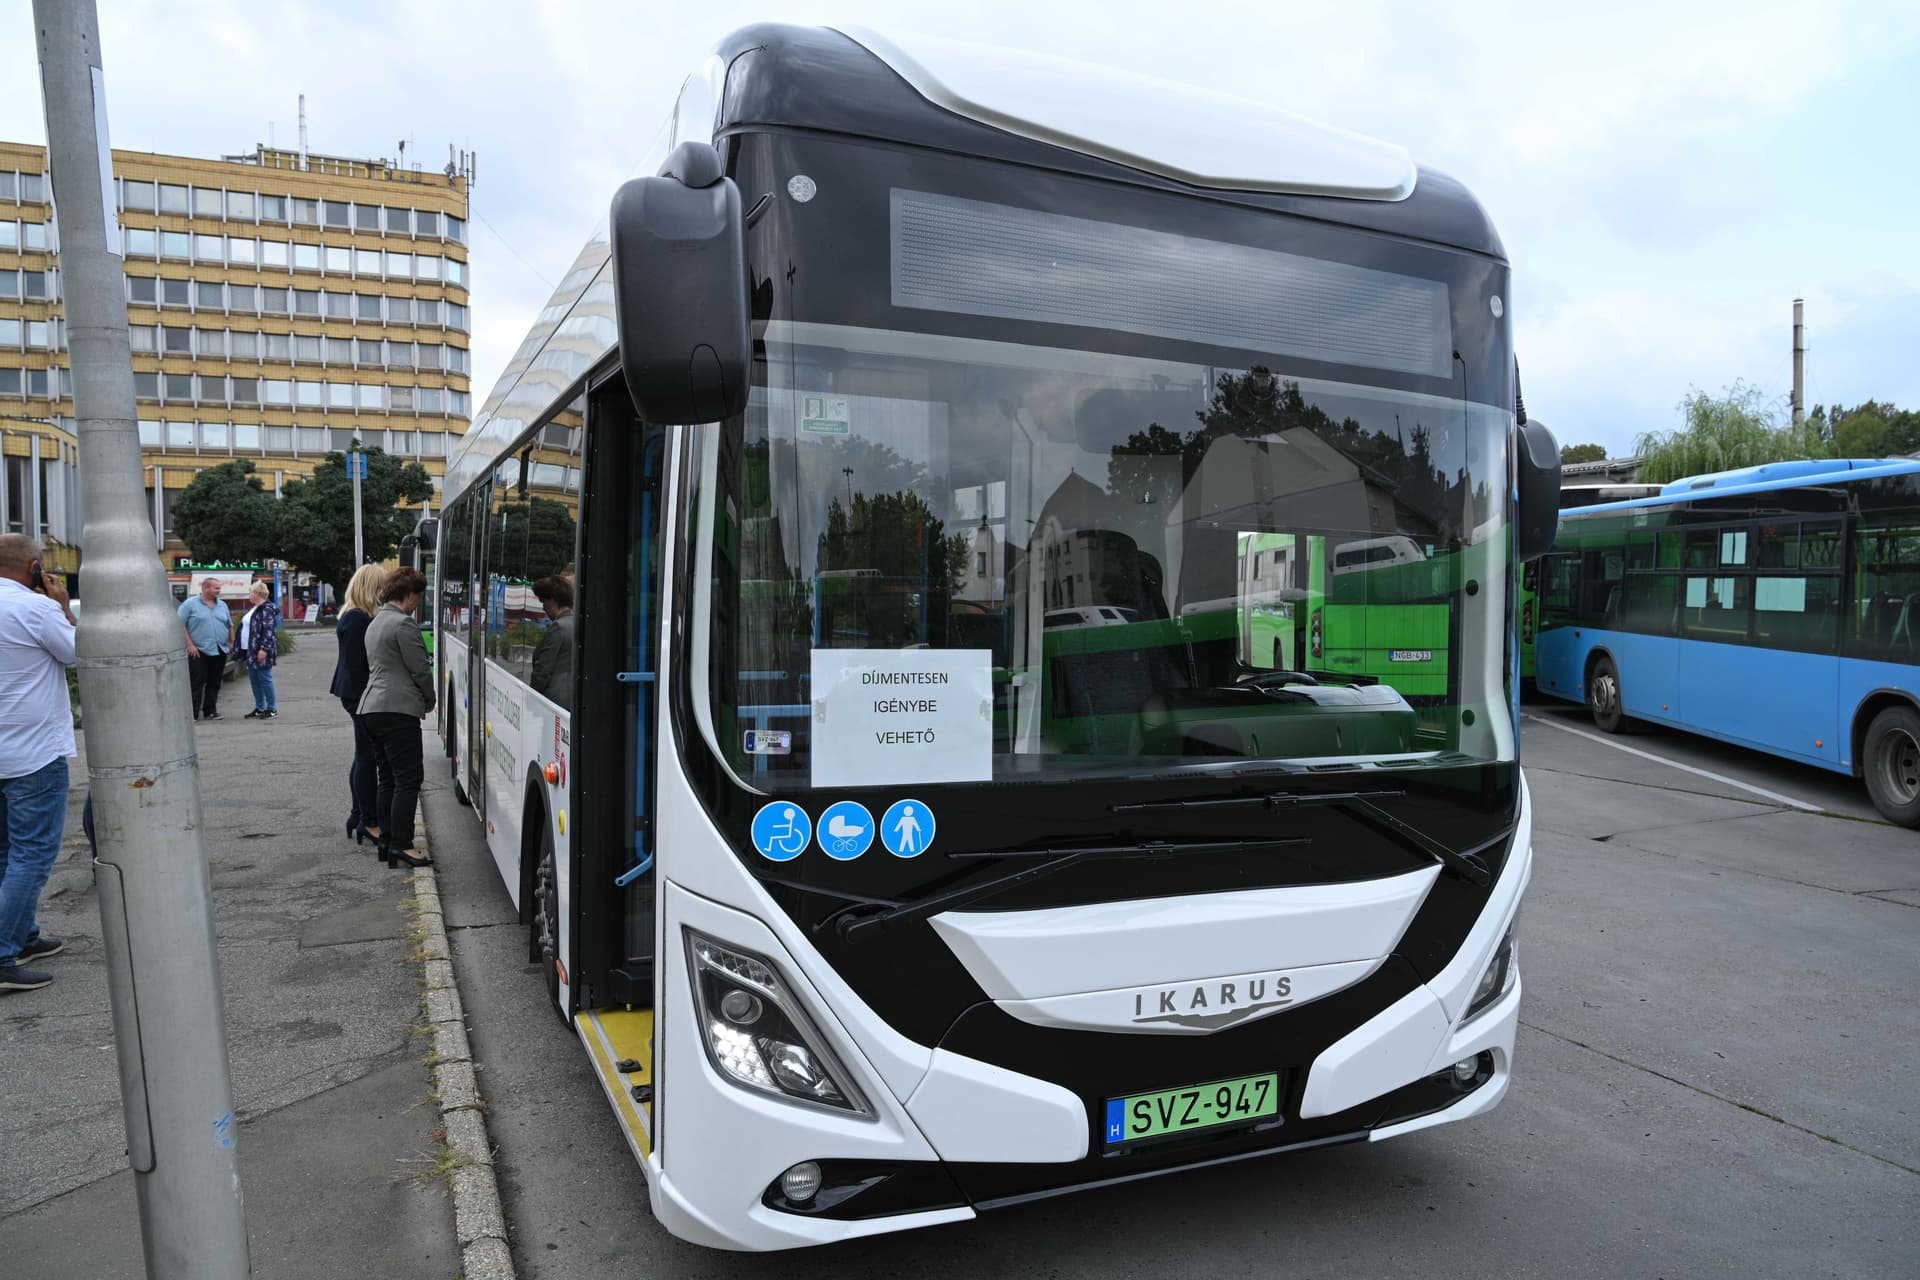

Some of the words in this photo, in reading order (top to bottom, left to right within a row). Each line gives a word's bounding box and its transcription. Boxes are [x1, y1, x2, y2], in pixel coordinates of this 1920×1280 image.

[861, 670, 948, 686] DÍJMENTESEN
[873, 697, 937, 714] IGÉNYBE
[875, 729, 935, 745] VEHETŐ
[1135, 976, 1292, 1016] IKARUS
[1110, 1124, 1120, 1137] H
[1132, 1079, 1271, 1134] SVZ-947
